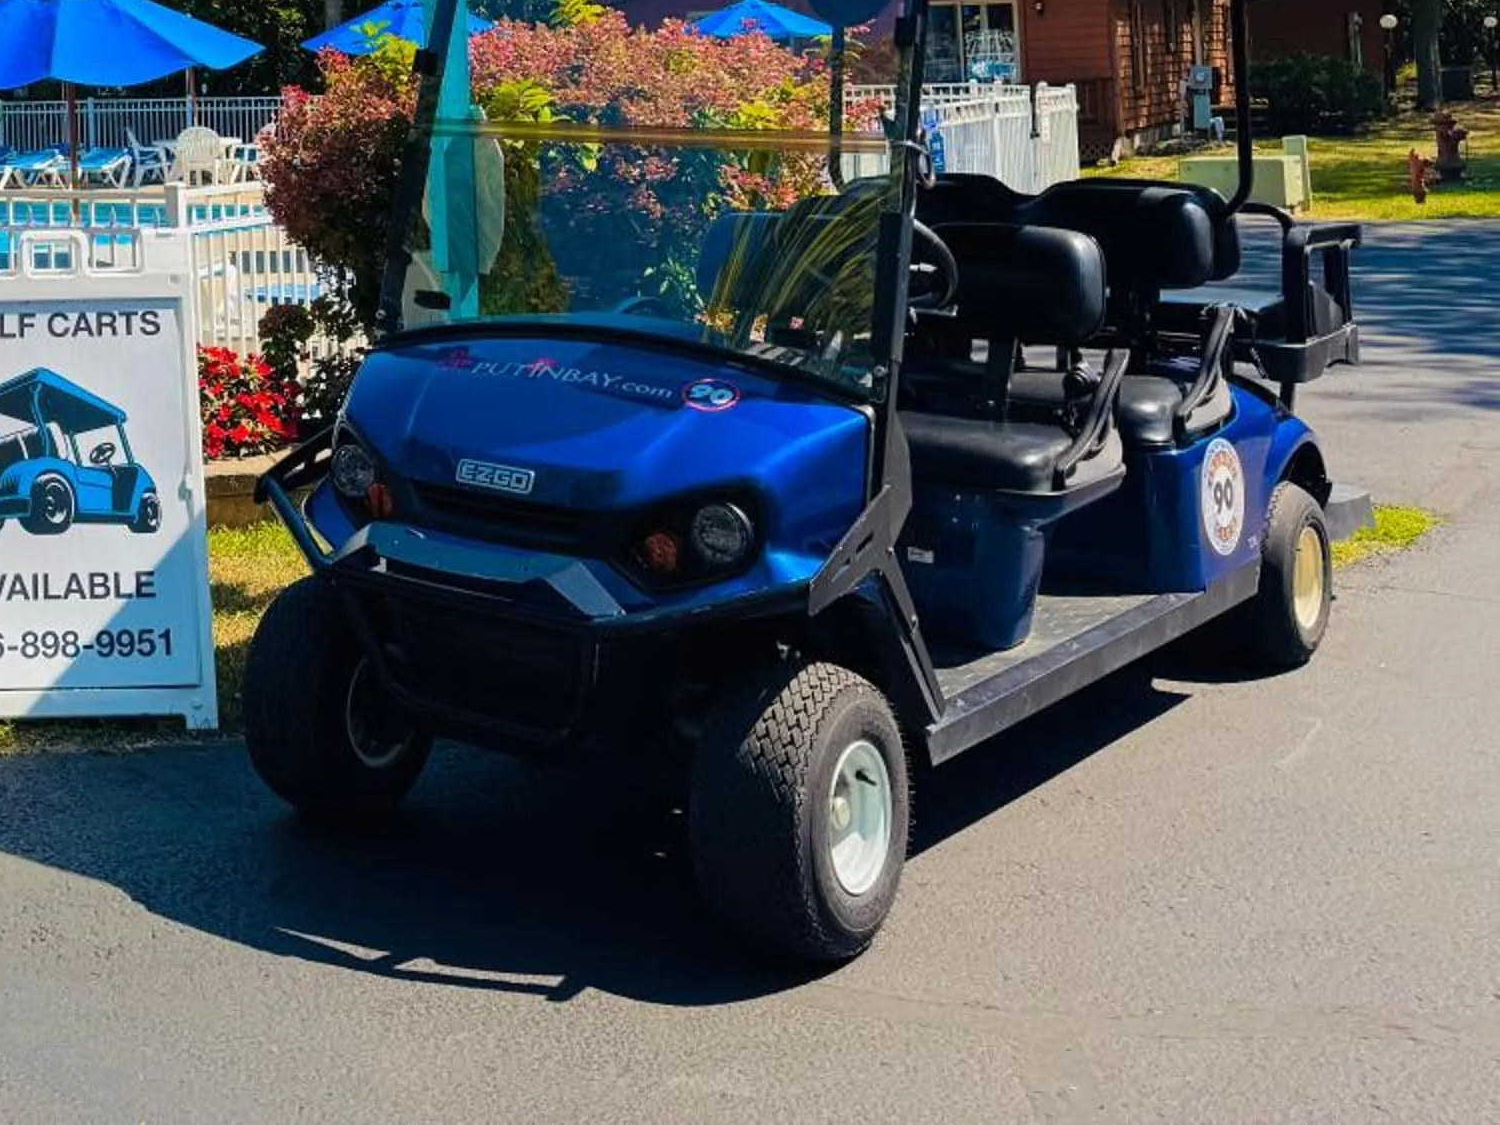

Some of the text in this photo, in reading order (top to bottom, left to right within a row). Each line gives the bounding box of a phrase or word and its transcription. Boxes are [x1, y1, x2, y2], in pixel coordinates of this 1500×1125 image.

[47, 310, 162, 338] CARTS
[688, 384, 734, 406] 90
[1213, 477, 1234, 515] 90
